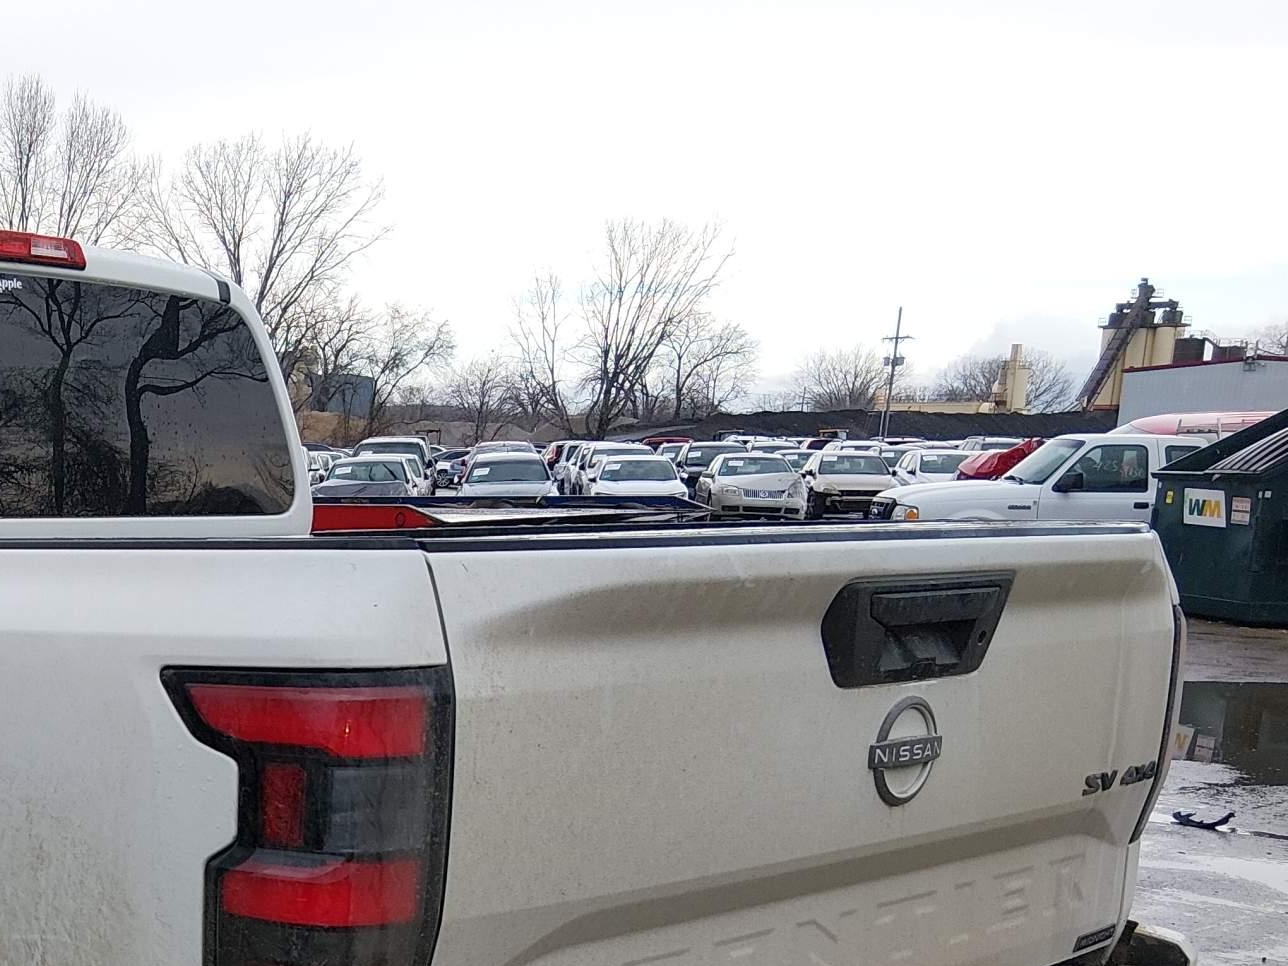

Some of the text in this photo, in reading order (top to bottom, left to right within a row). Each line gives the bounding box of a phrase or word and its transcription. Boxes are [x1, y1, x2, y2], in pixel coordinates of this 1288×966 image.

[1188, 498, 1221, 518] WM
[874, 740, 941, 764] NISSAN
[1082, 769, 1118, 796] SV
